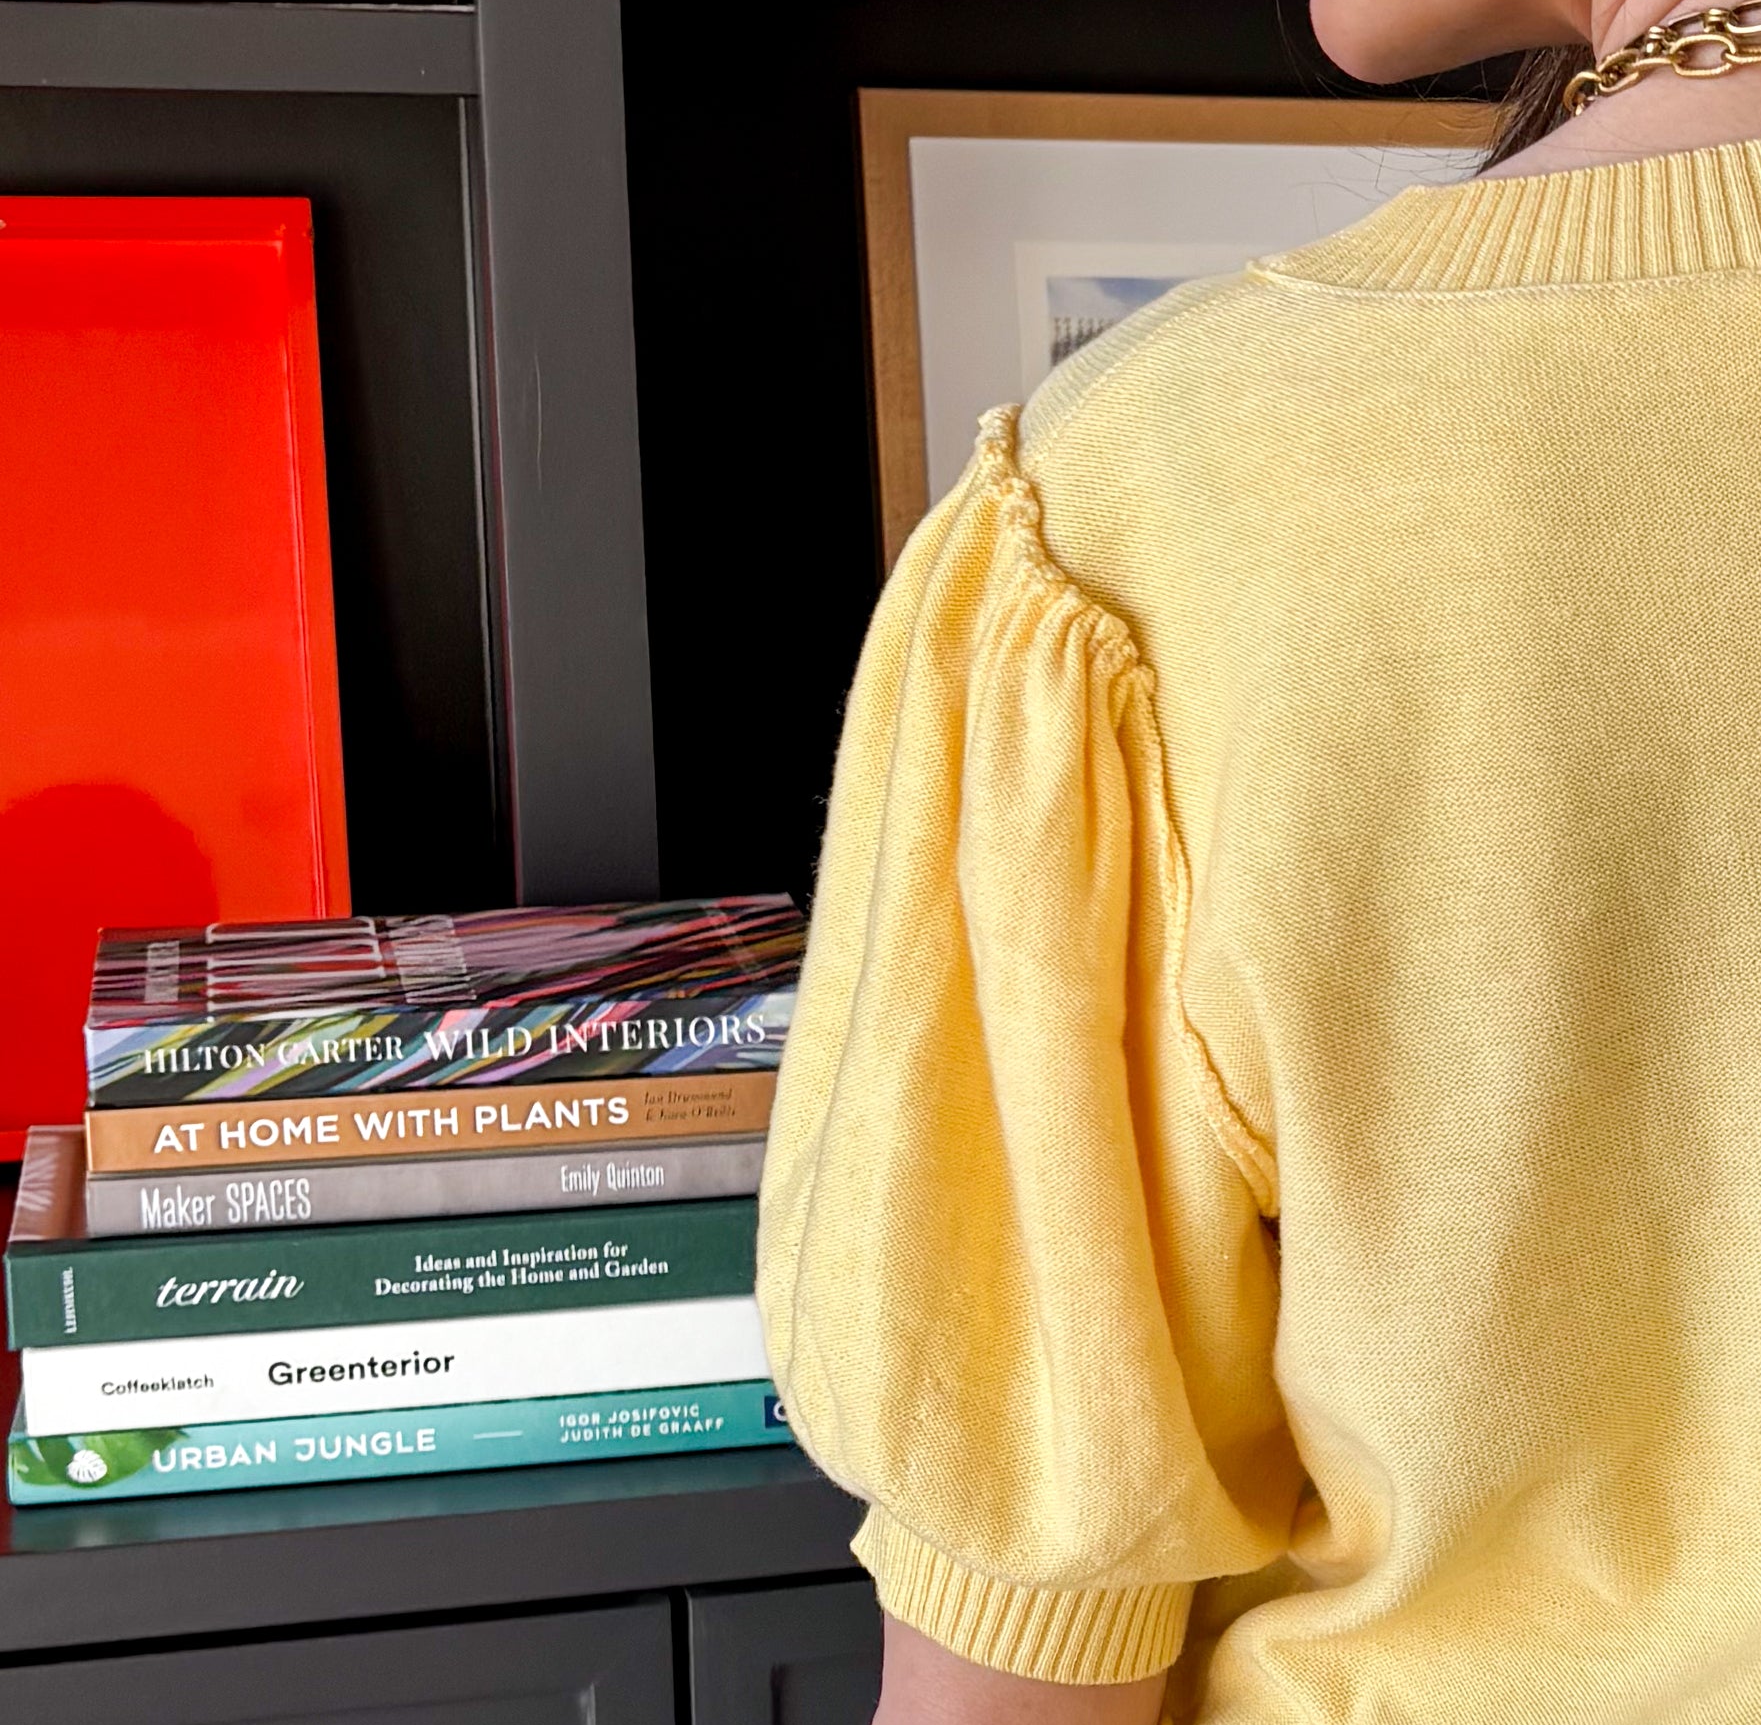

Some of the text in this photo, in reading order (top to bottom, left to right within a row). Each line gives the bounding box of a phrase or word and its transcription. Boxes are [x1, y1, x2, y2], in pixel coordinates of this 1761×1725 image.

[144, 1013, 766, 1074] HILTON CARTER WILD INTERIORS
[154, 1096, 630, 1154] AT HOME WITH PLANTS
[560, 1161, 665, 1196] Emily Quinton
[140, 1177, 312, 1230] Maker SPACES
[414, 1240, 629, 1273] Ideas and Inspiration for
[155, 1269, 305, 1308] terrain
[374, 1258, 669, 1296] Decorating the Home and Garden
[101, 1374, 215, 1397] Coffeeklatch
[267, 1350, 456, 1386] Greenterior
[559, 1403, 700, 1428] IGOR JOSIFOVIC
[560, 1417, 725, 1443] JUDITH DE GRAAFF
[152, 1428, 437, 1473] URBAN JUNGLE
